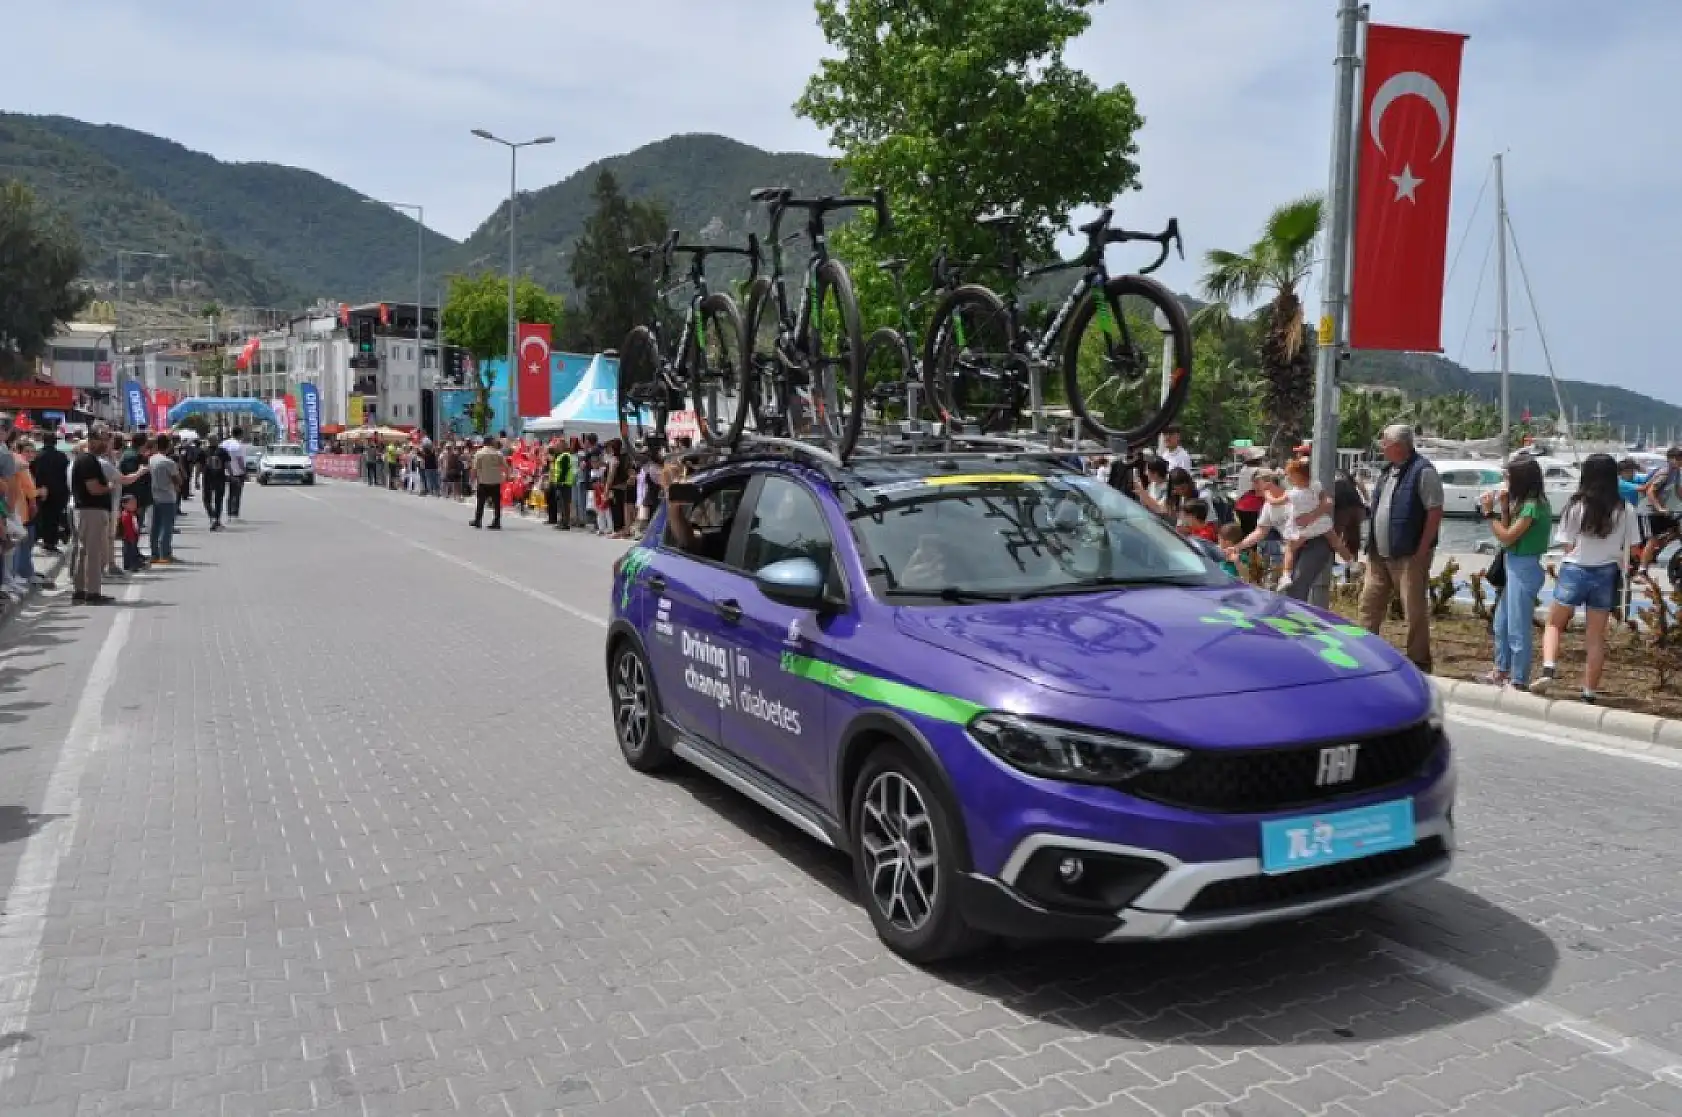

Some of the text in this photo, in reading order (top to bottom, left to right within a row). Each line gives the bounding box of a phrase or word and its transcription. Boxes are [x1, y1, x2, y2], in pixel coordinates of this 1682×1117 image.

[682, 629, 751, 679] Driving in
[685, 664, 803, 735] change diabetes
[1316, 743, 1361, 787] FIAT
